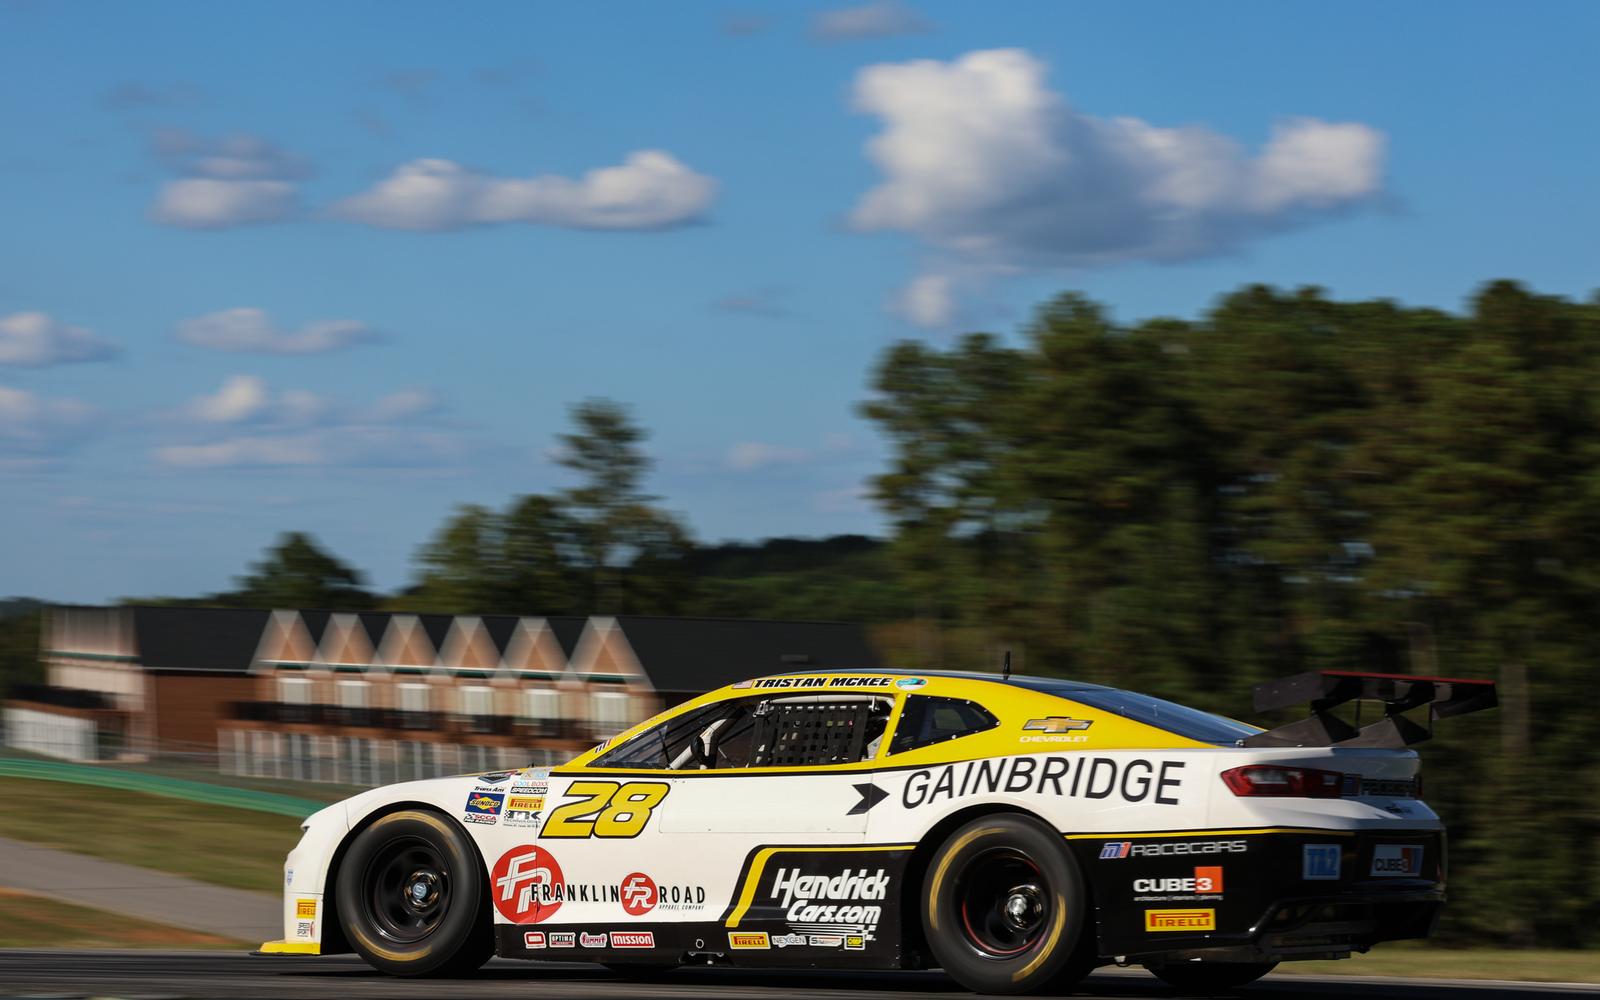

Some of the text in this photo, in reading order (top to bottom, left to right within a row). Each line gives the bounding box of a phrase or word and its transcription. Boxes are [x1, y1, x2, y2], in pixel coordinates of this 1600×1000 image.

[754, 678, 828, 688] TRISTAN
[829, 677, 893, 687] MCKEE
[1019, 735, 1089, 743] CHEVROLET
[902, 757, 1186, 810] GAINBRIDGE
[470, 799, 500, 807] SUNOCO
[510, 799, 542, 809] PIRELLI
[538, 781, 671, 839] 28
[770, 868, 891, 909] Hendrick
[1133, 878, 1213, 892] CUBE3
[530, 885, 619, 902] FRANKLIN
[659, 886, 705, 904] ROAD
[786, 900, 882, 925] Cars.com
[1150, 912, 1211, 927] PIRELLI
[613, 935, 652, 944] MISSION
[733, 936, 765, 945] PIRELLI
[773, 936, 805, 944] NEXGEN
